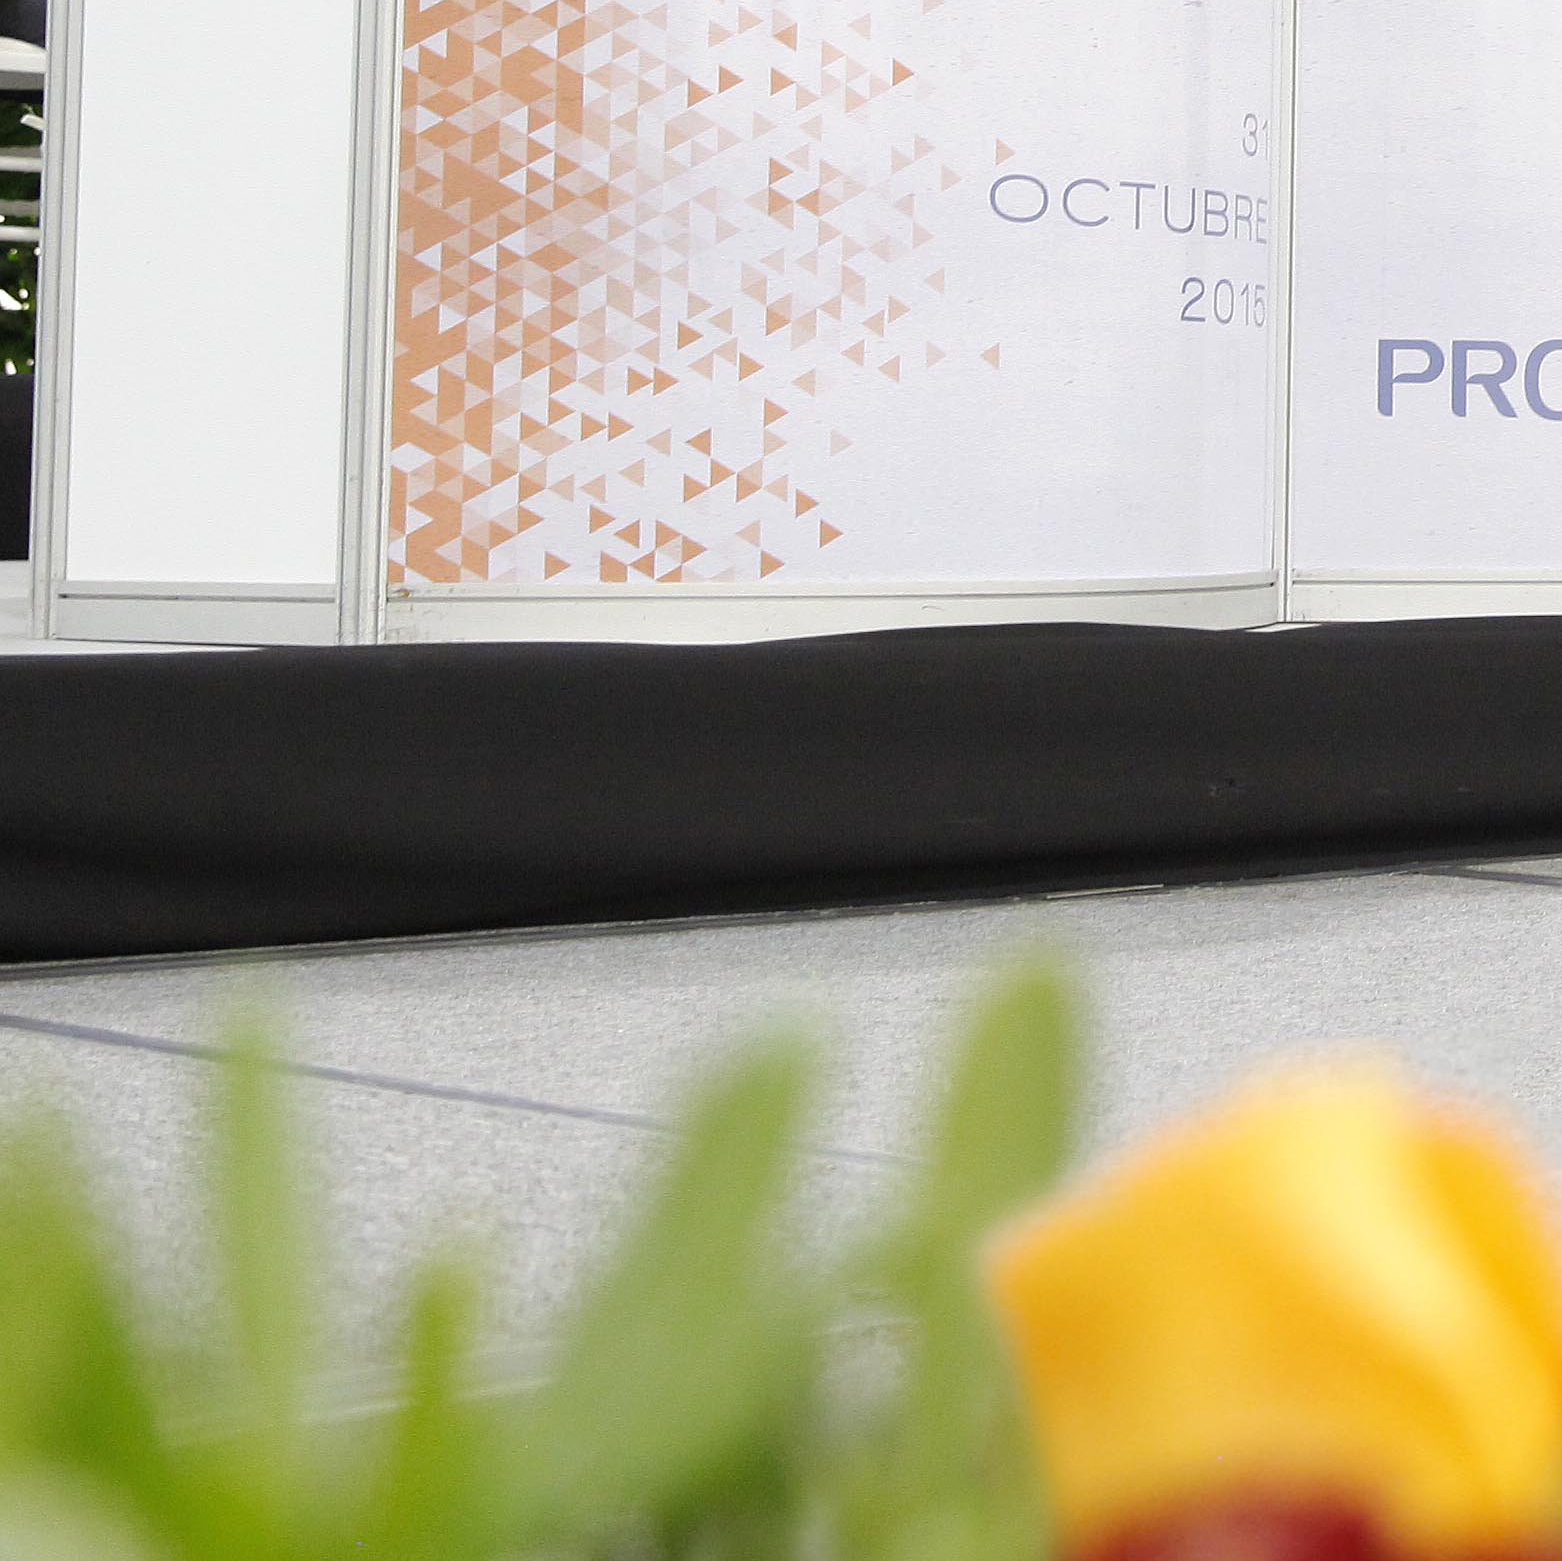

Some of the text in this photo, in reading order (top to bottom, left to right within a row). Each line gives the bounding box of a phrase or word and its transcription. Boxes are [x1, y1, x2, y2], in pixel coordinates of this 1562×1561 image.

[1241, 112, 1268, 160] 31
[988, 174, 1267, 244] OCTUBRE
[1180, 276, 1266, 328] 2015
